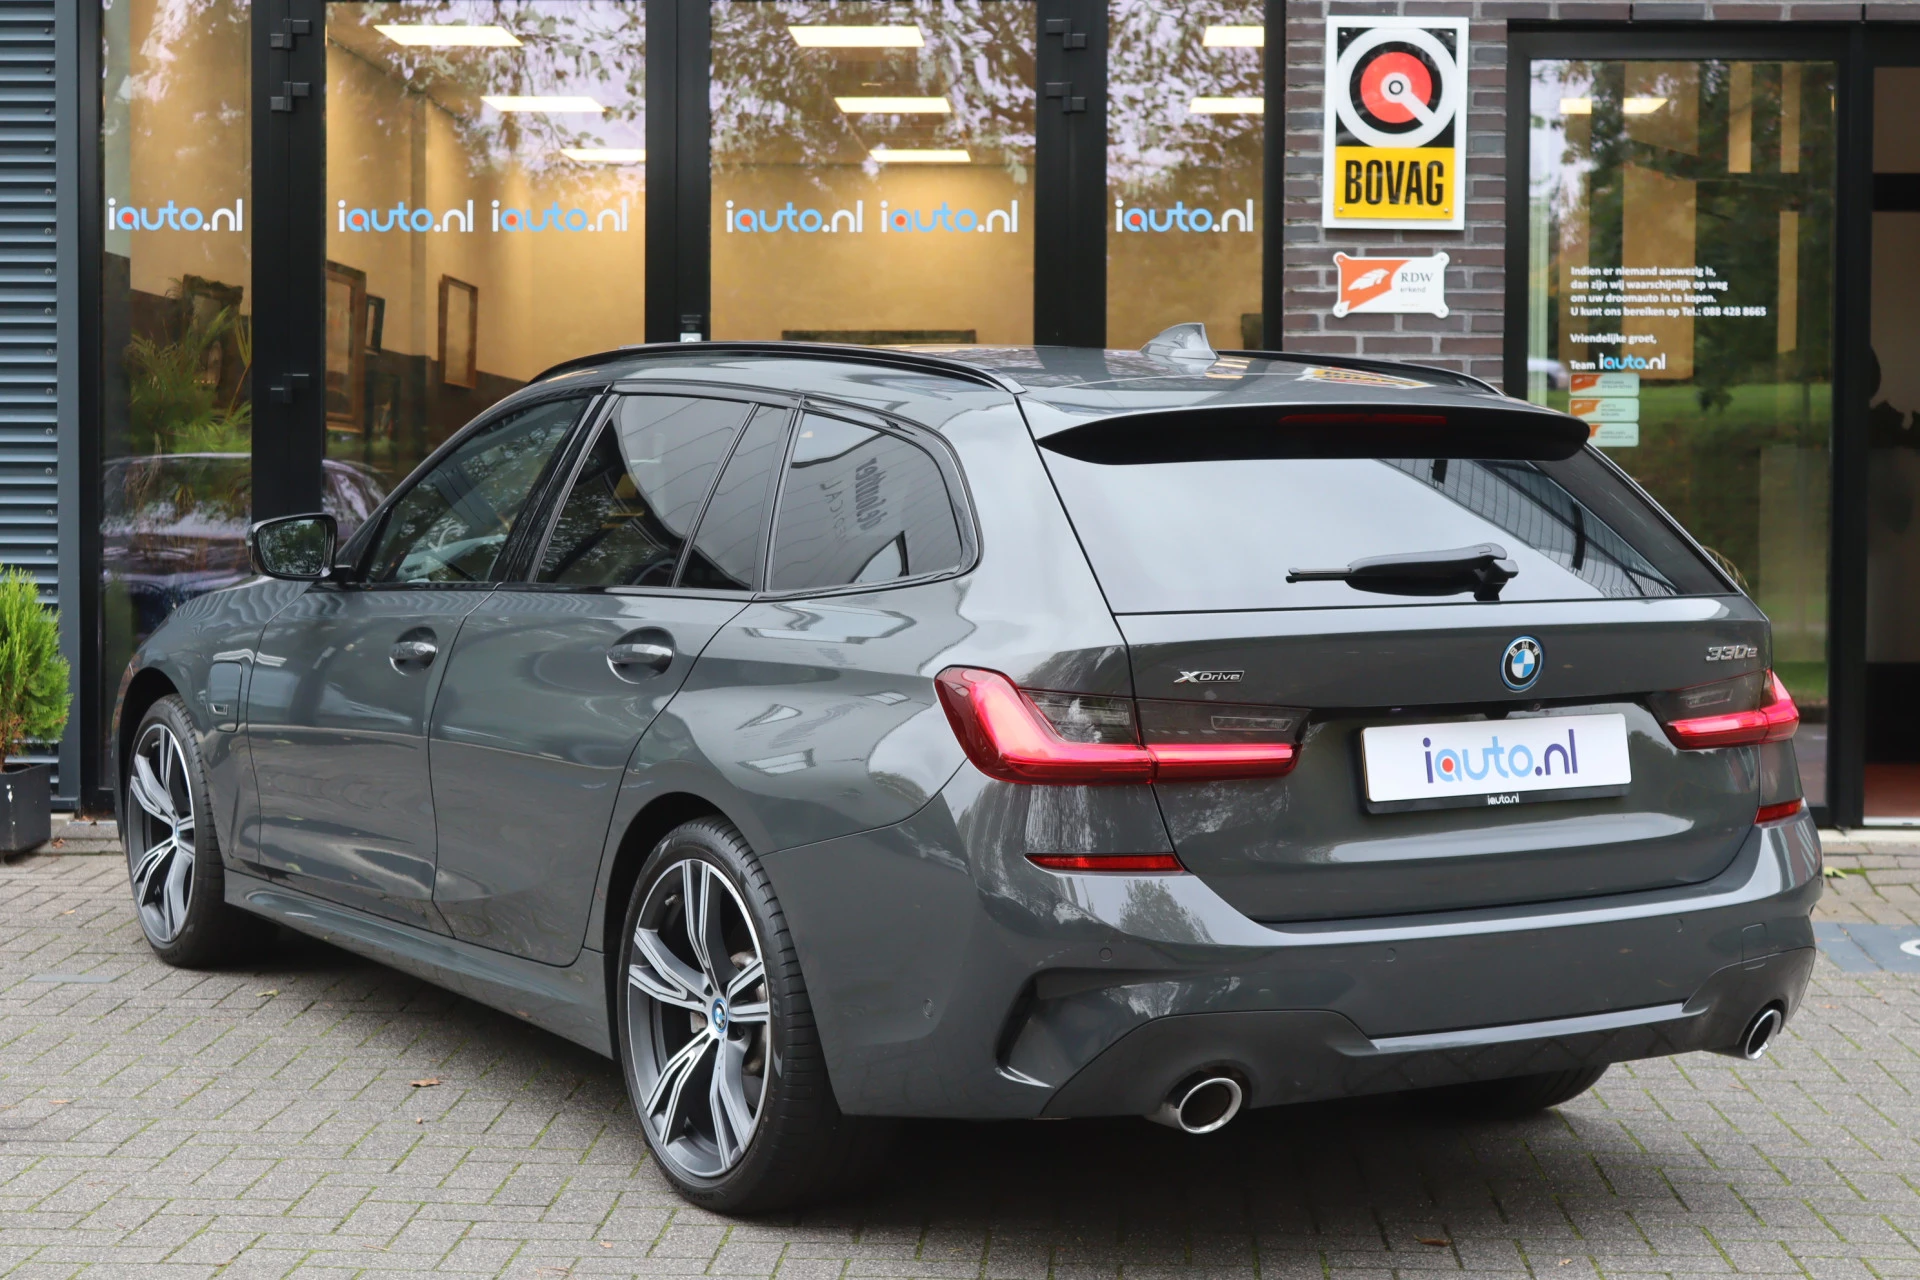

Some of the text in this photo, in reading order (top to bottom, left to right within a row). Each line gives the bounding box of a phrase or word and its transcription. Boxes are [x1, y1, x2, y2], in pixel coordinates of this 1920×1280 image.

[1344, 159, 1444, 206] BOVAG
[107, 198, 242, 232] iauto.nl
[338, 199, 473, 232] iauto.nl
[491, 199, 628, 232] iauto.nl
[726, 199, 863, 233] iauto.nl
[880, 199, 1018, 233] iauto.nl
[1116, 198, 1254, 233] iauto.nl
[1401, 272, 1433, 282] RDW
[1570, 265, 1717, 278] Indien er niemand aanwezig is,
[1570, 280, 1728, 291] dan zijn wij waarschijnlijk op weg
[1570, 293, 1717, 304] om uw droomauto in te kopen.
[1570, 307, 1767, 318] U kunt ons bereiken op Tel.: 088 428 8665
[1570, 333, 1657, 345] Vriendelijke groet,
[1569, 353, 1666, 370] Team iauto.nl
[1509, 640, 1541, 657] BMW
[1706, 645, 1758, 661] 330e
[1423, 729, 1578, 783] iauto.nl
[1487, 792, 1520, 806] iauto.nl
